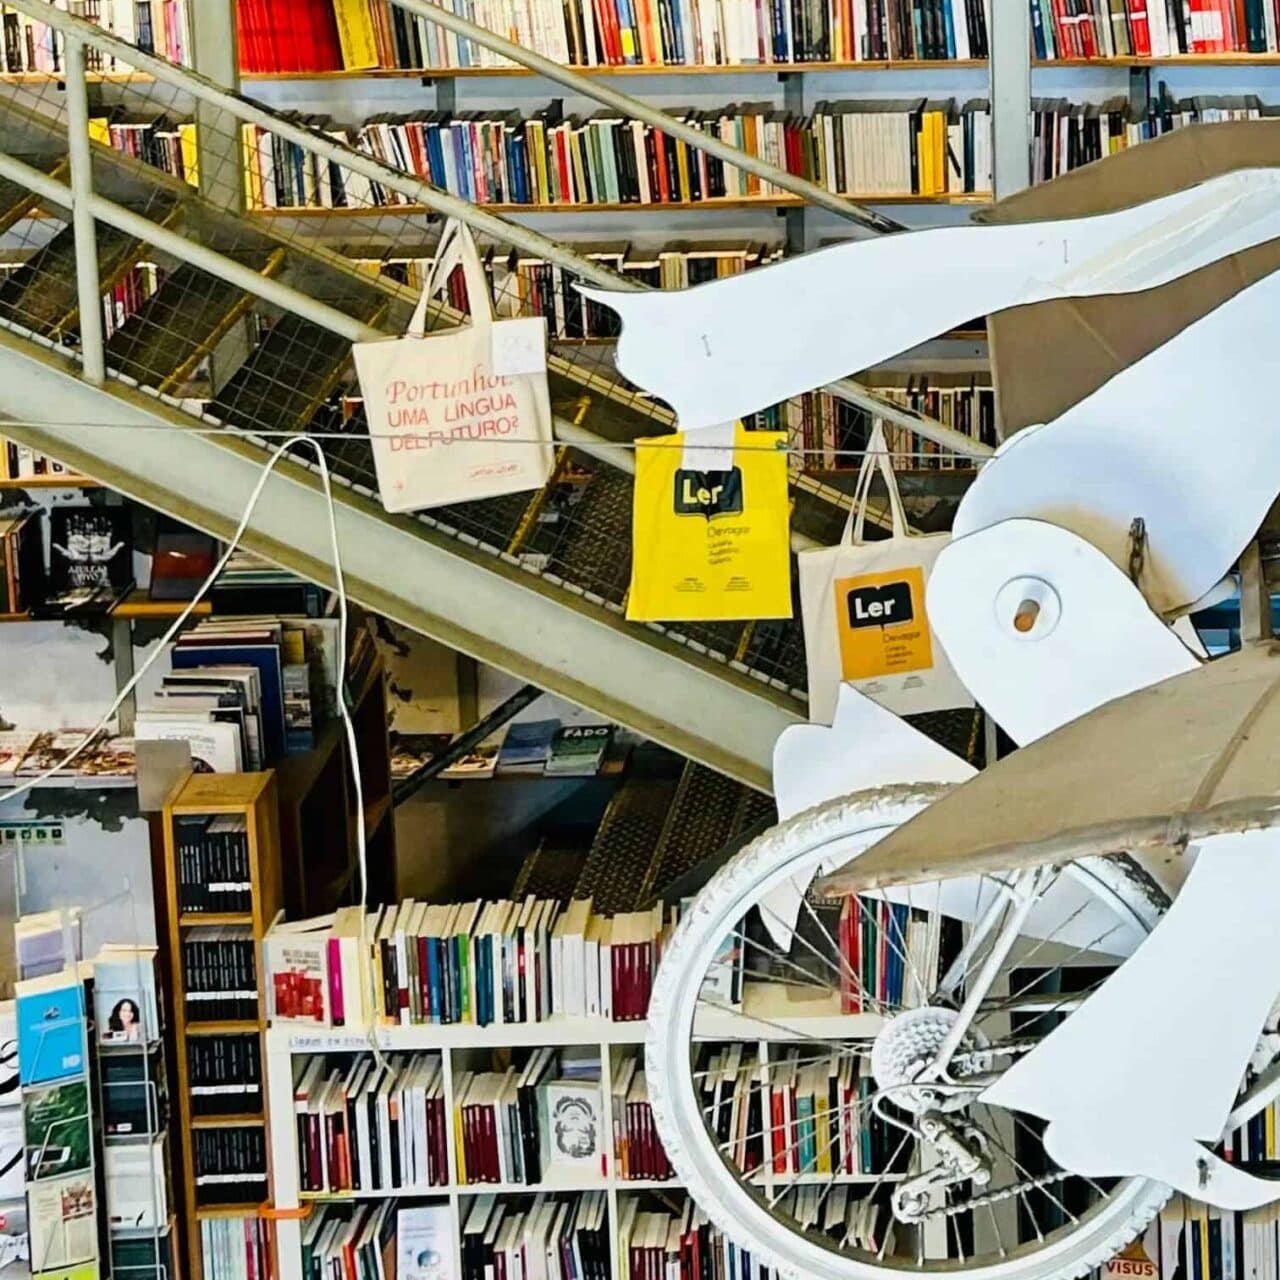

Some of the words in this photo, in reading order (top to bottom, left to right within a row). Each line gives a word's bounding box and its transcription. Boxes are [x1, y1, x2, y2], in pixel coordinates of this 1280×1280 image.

[387, 408, 429, 428] UMA
[682, 479, 722, 505] Ler
[854, 597, 896, 620] Ler
[1105, 1261, 1153, 1276] VISUS
